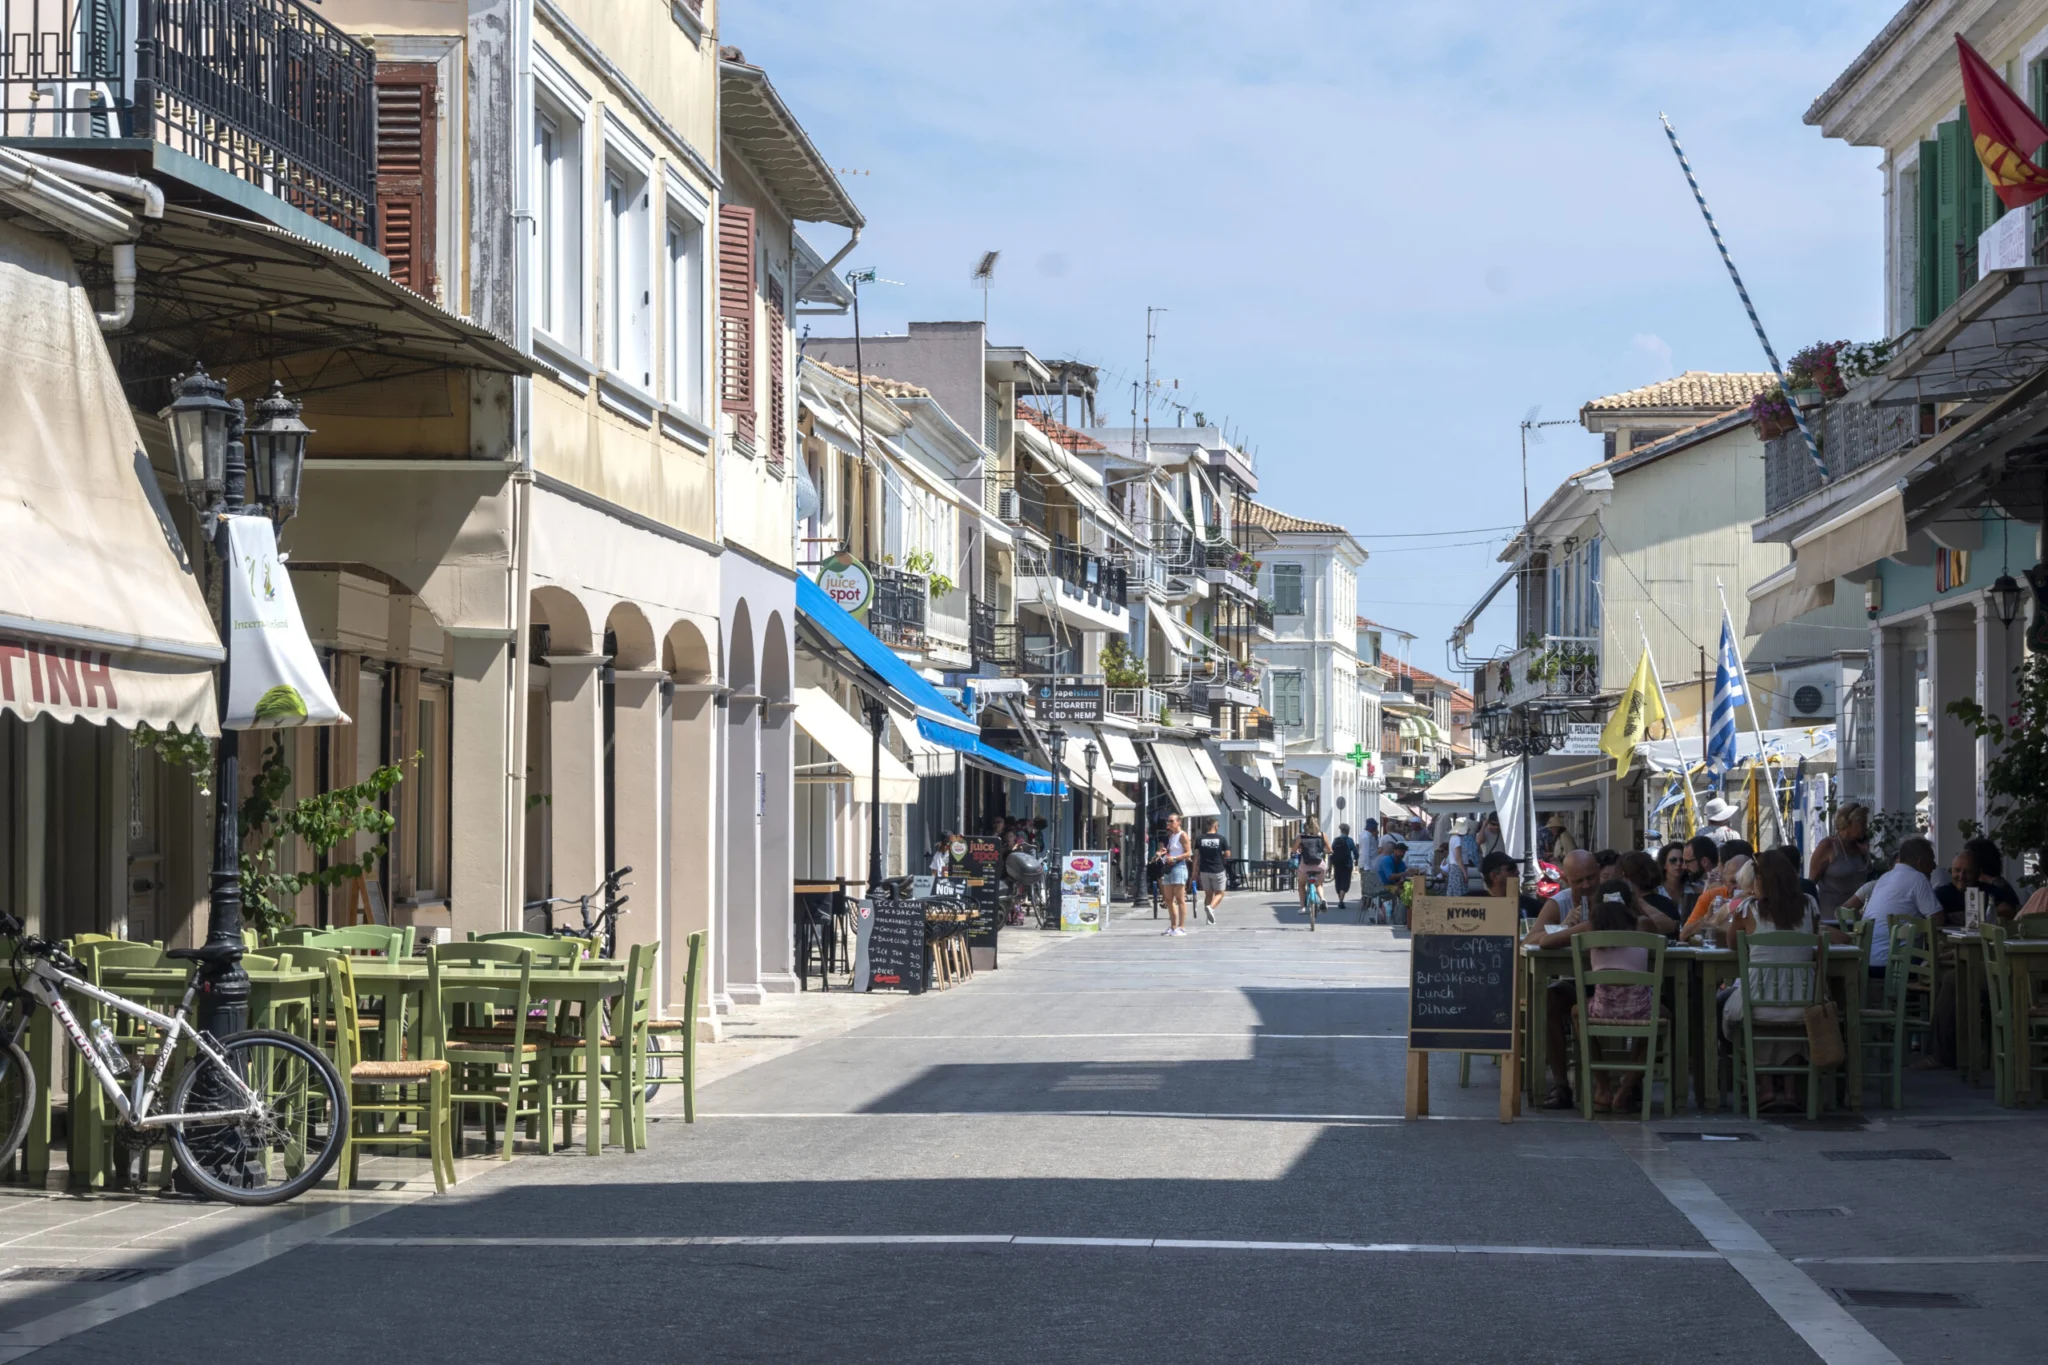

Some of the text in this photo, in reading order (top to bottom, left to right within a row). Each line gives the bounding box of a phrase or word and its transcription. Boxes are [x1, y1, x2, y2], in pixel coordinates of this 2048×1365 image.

[826, 575, 856, 590] juice
[829, 588, 861, 604] spot
[1042, 701, 1047, 709] E
[1054, 701, 1097, 709] CIGARETTE
[1048, 711, 1067, 719] CBD
[1074, 711, 1096, 719] HEMP
[969, 840, 995, 854] juice
[973, 850, 999, 863] spot
[1447, 907, 1486, 920] ΝΥΜΦΗ
[1452, 938, 1502, 955] Coffee
[1439, 954, 1486, 971] Drinks
[1416, 971, 1484, 985] Breakfast
[1416, 984, 1454, 999] Lunch
[1418, 1002, 1467, 1015] Dinner
[157, 1042, 172, 1072] FOCUS
